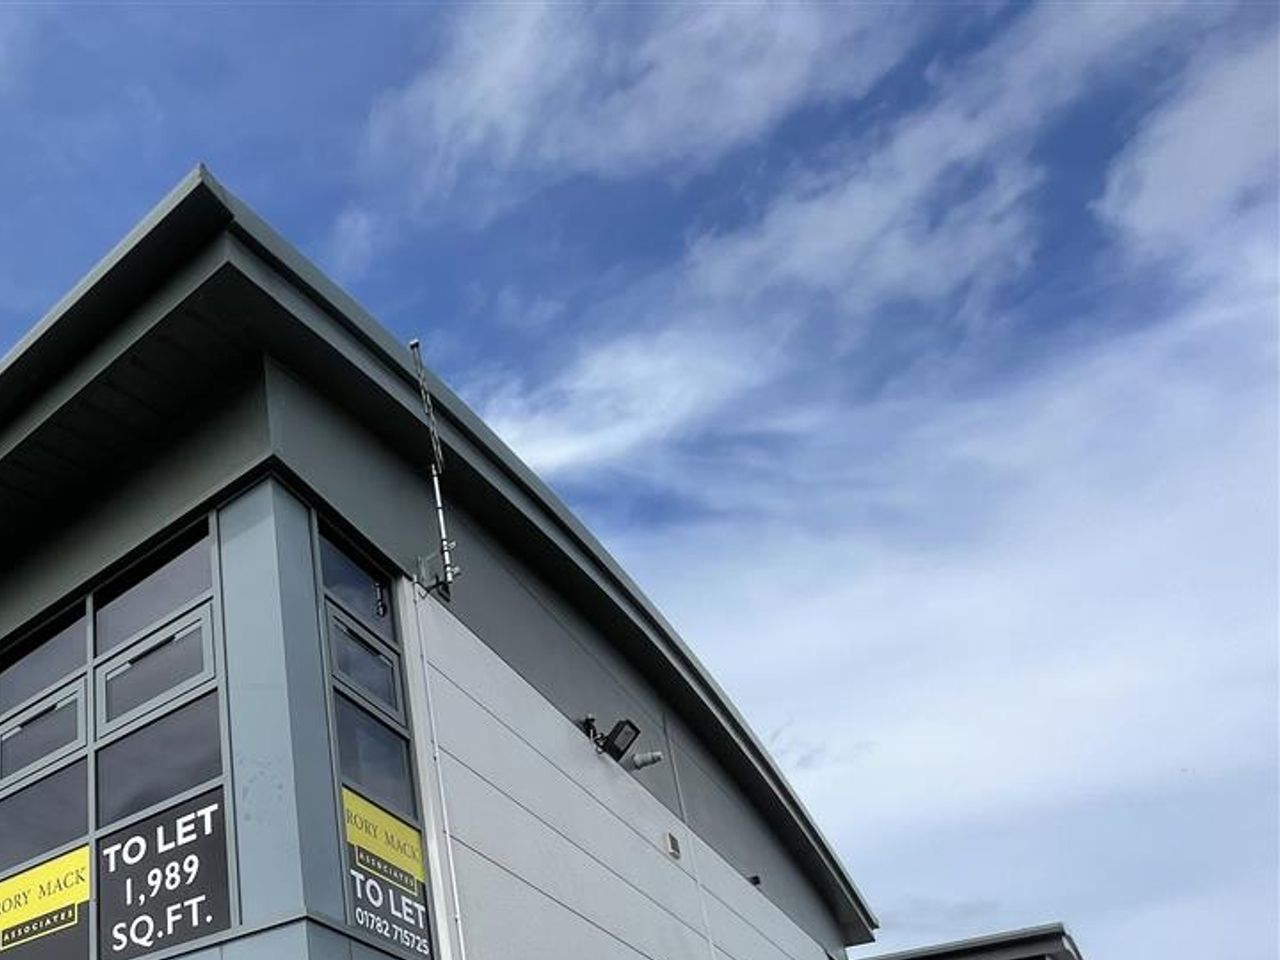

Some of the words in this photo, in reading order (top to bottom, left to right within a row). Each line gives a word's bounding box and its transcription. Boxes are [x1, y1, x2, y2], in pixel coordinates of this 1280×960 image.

[103, 836, 147, 872] TO
[156, 803, 219, 853] LET
[346, 808, 379, 838] RORY
[384, 831, 420, 860] MACK
[37, 867, 86, 900] MACK
[126, 854, 199, 906] 1,989
[350, 869, 382, 908] TO
[389, 889, 425, 929] LET
[3, 910, 73, 941] ASSOCIATES
[112, 895, 213, 951] SQ.FT.
[356, 908, 391, 939] 01782
[392, 923, 430, 955] 715725
